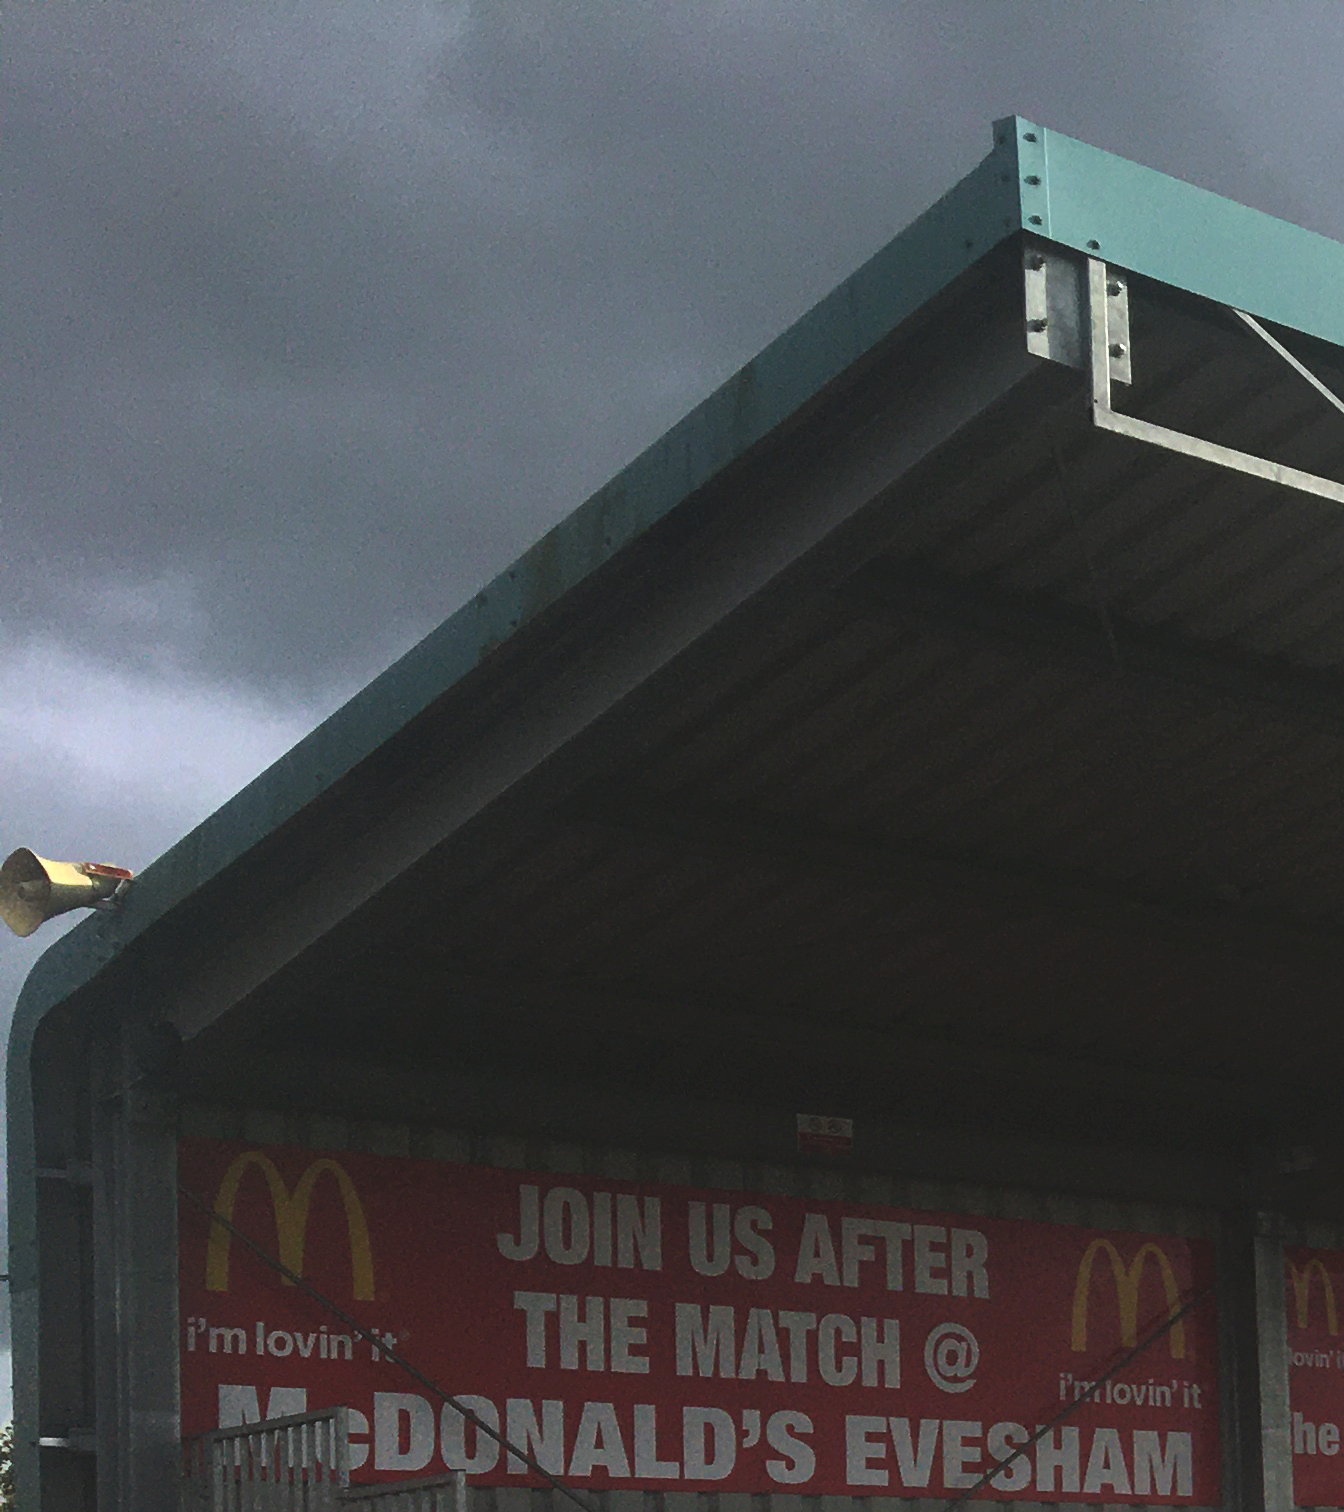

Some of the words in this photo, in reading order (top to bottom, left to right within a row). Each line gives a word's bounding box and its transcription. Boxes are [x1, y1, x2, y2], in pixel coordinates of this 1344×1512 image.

[496, 1183, 663, 1272] JOIN
[687, 1200, 776, 1281] US
[794, 1213, 990, 1299] AFTER
[186, 1317, 248, 1355] i'm
[255, 1321, 362, 1361] lovin'
[371, 1327, 398, 1362] it
[513, 1290, 650, 1374] THE
[675, 1302, 900, 1389] MATCH
[923, 1322, 979, 1394] @
[1059, 1372, 1101, 1403] i'm
[1105, 1378, 1178, 1408] lovin'
[1183, 1380, 1202, 1409] it
[845, 1414, 1194, 1496] EVESHAM
[1292, 1411, 1341, 1457] he
